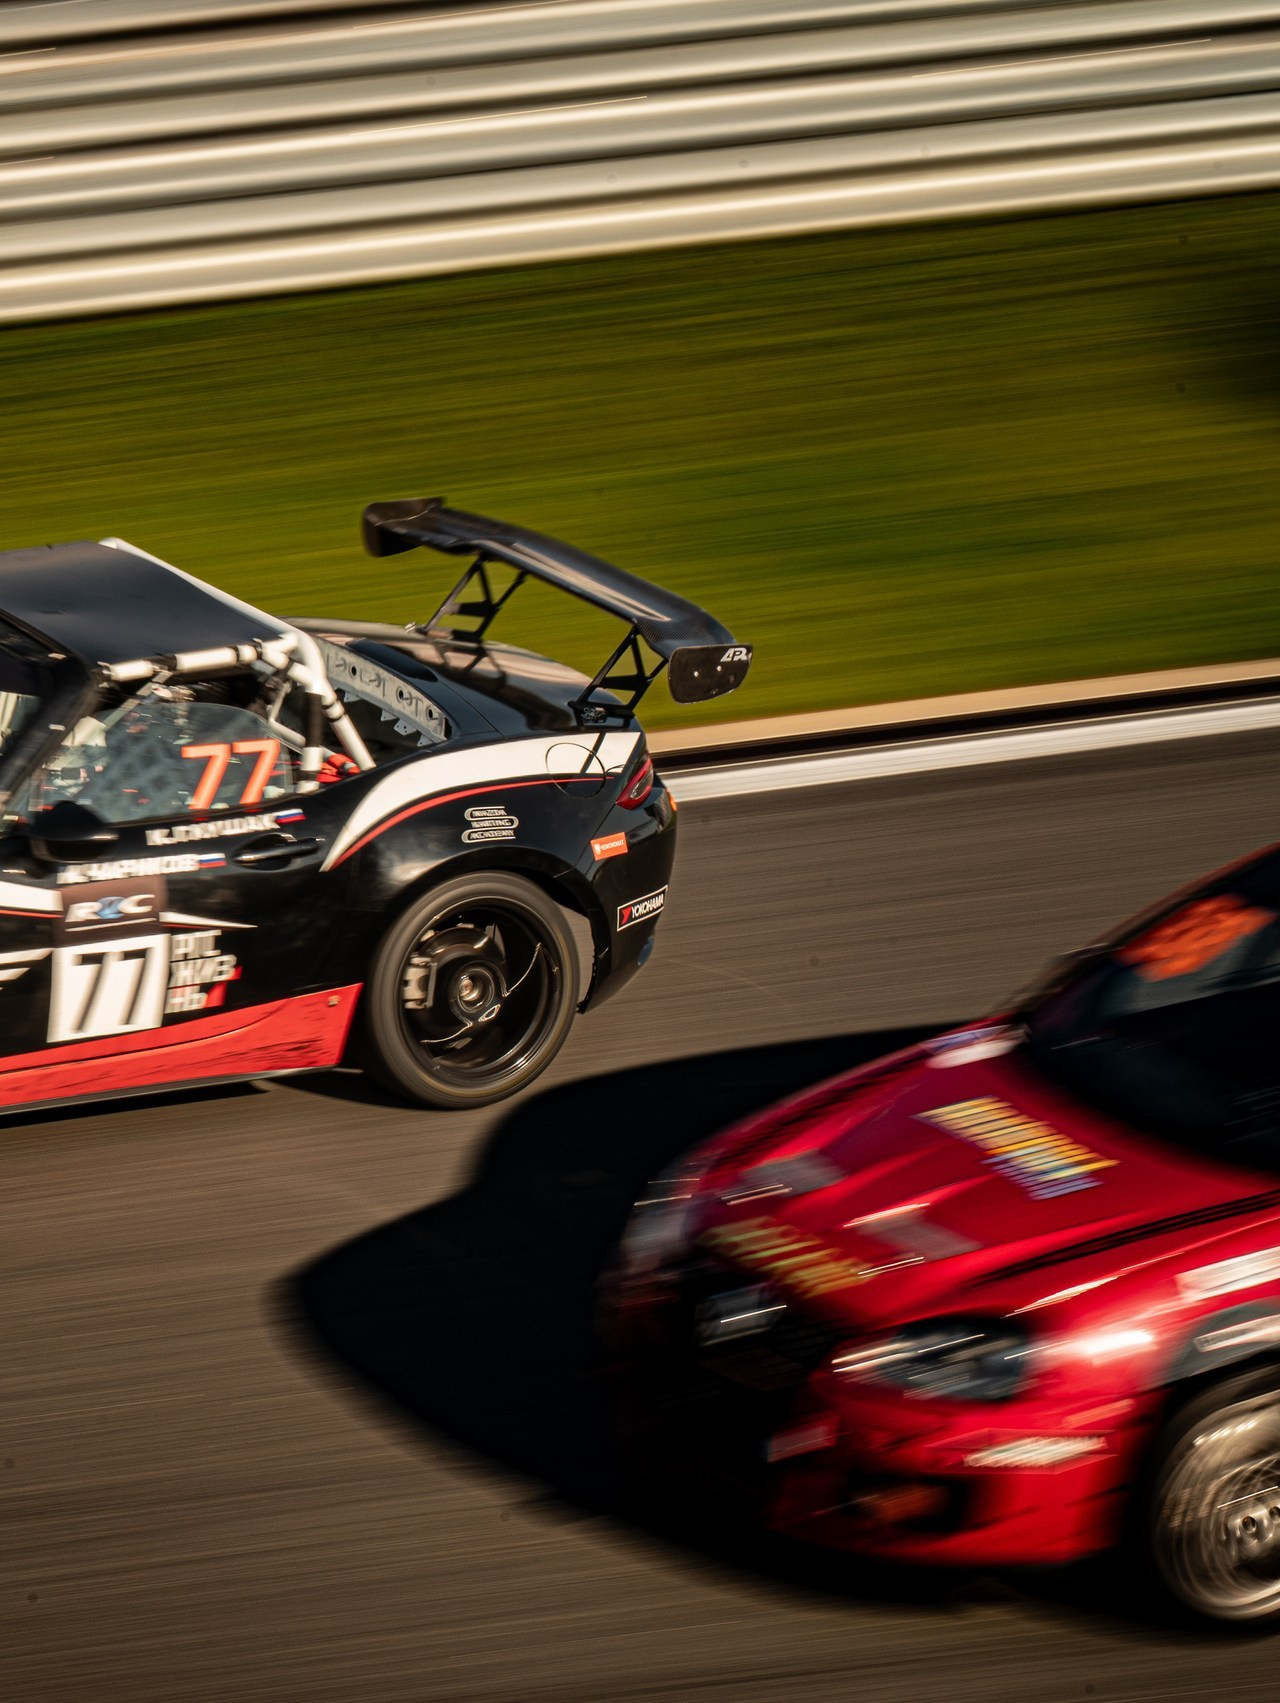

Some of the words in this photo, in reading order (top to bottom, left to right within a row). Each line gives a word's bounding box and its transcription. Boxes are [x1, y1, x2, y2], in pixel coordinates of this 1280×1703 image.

[181, 738, 281, 810] 77
[631, 893, 664, 918] YOKOHAMA
[71, 947, 155, 1034] 77
